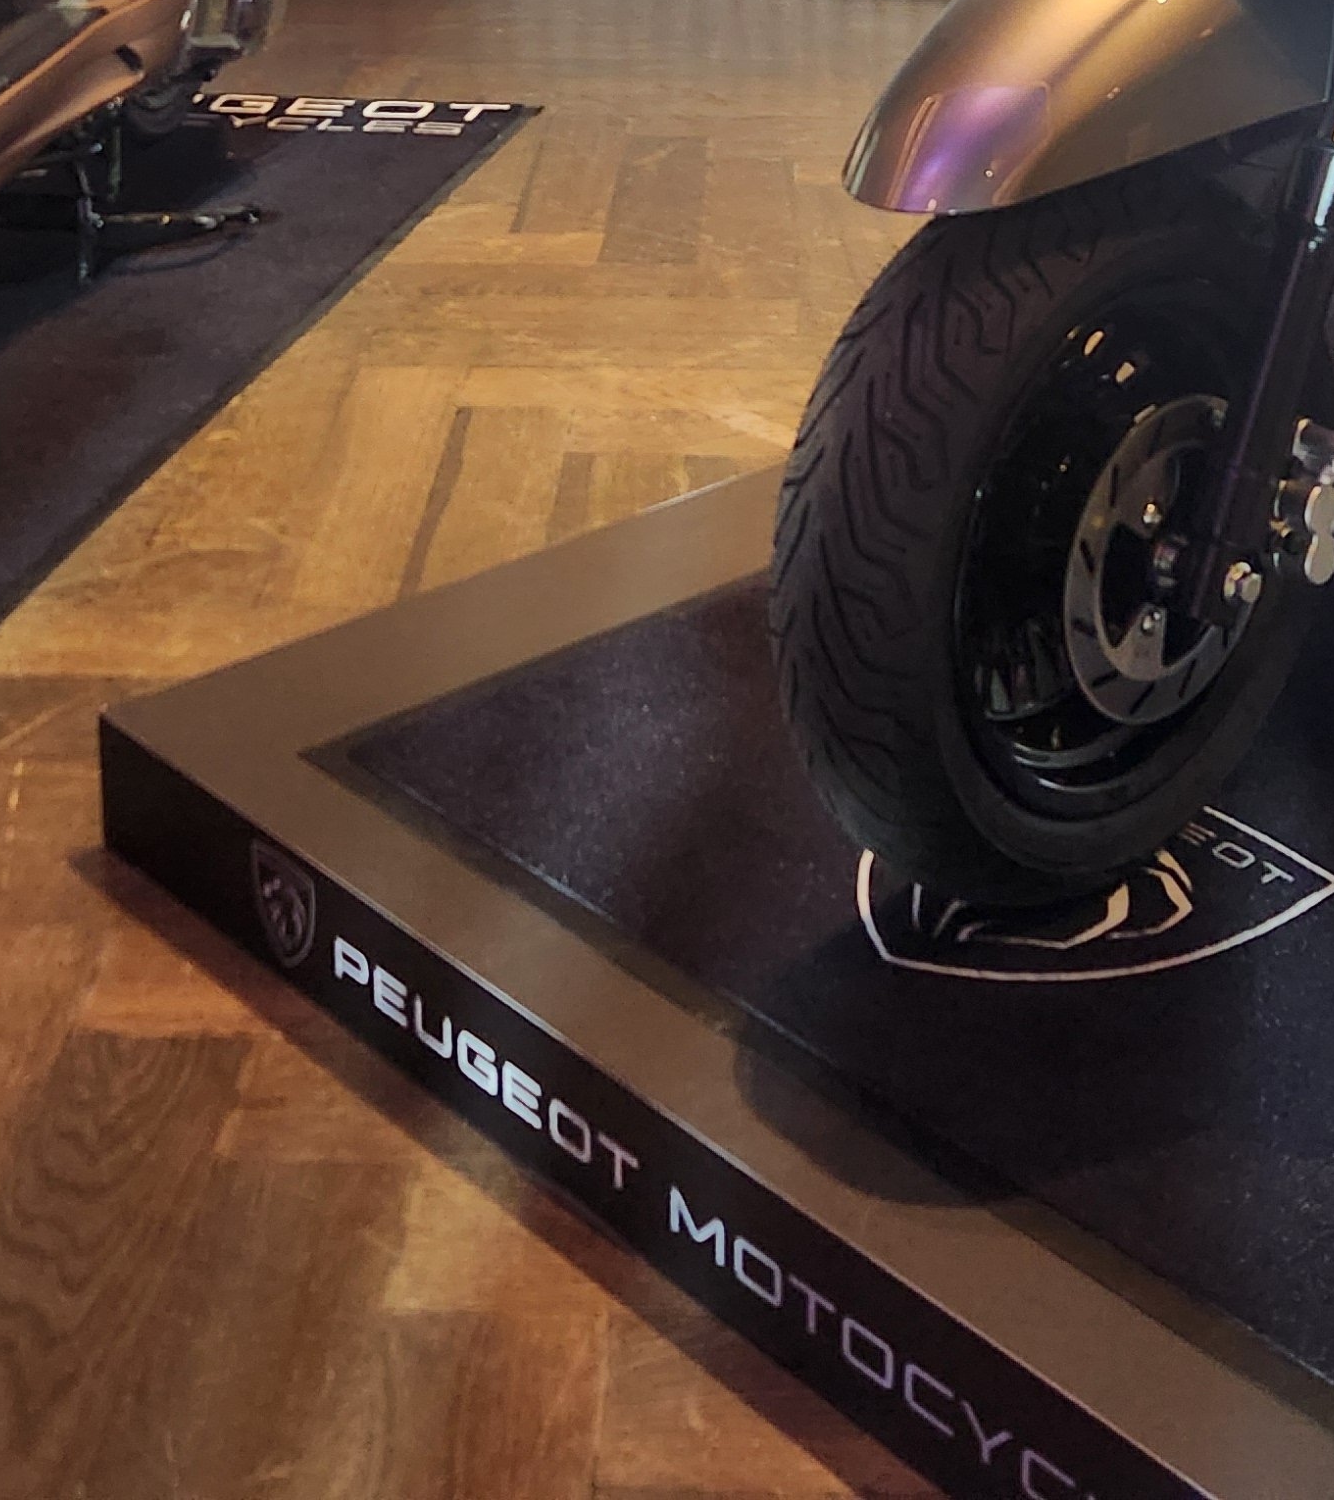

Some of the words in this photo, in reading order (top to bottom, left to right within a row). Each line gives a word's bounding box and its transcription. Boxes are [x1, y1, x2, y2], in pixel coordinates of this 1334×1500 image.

[192, 93, 511, 122] GEOT
[182, 113, 466, 137] YCLES
[333, 934, 640, 1190] PEUGEOT
[668, 1185, 1095, 1500] MOTOCYC
